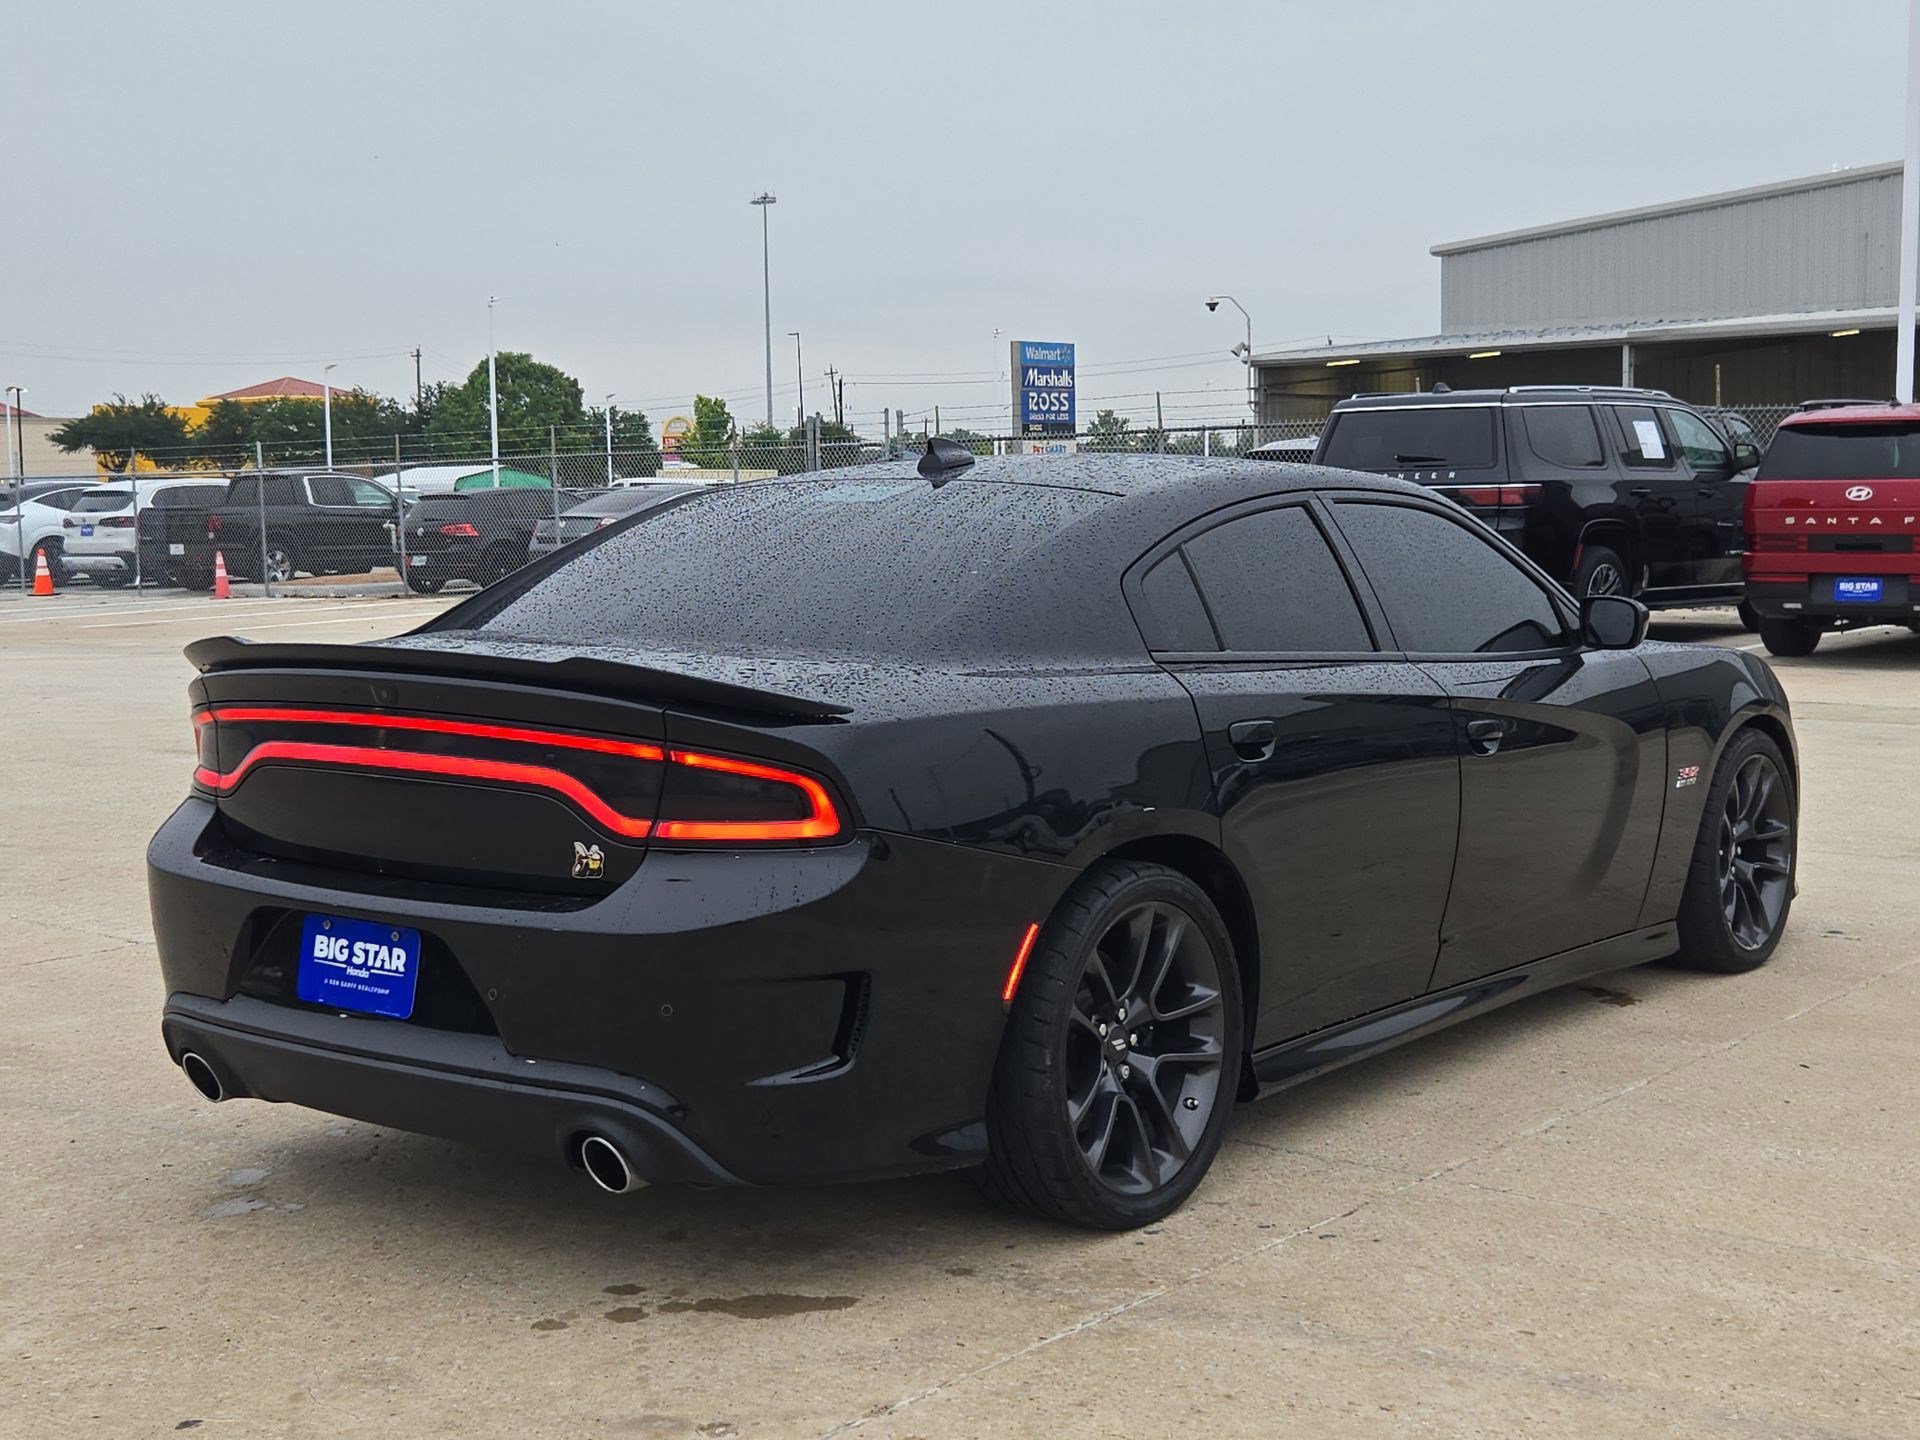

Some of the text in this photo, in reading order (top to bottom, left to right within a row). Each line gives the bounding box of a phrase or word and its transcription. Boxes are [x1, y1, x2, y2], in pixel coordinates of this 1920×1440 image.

[1025, 346, 1061, 361] Walmart
[1025, 368, 1072, 387] Marshalls
[1029, 392, 1069, 411] ROSS
[1785, 516, 1882, 525] SANTA
[1839, 582, 1878, 591] BIG STAR
[313, 934, 407, 972] BIG STAR
[346, 965, 370, 978] Honda
[357, 984, 390, 995] DEALERSHIP
